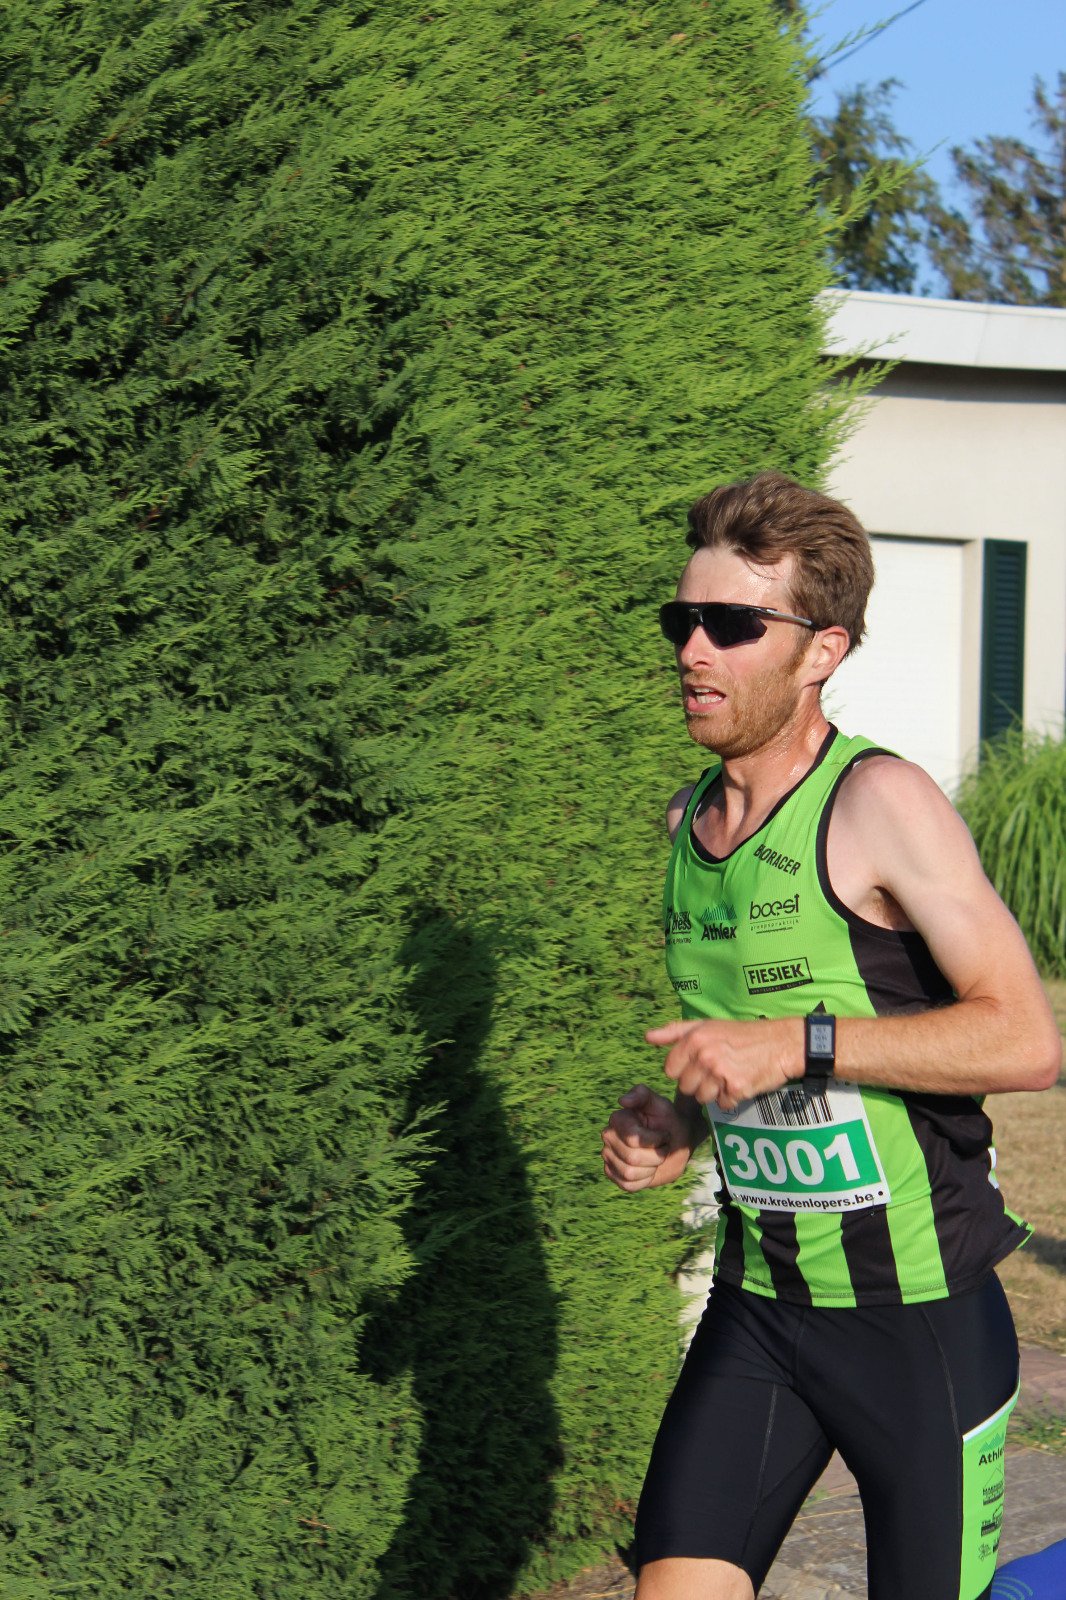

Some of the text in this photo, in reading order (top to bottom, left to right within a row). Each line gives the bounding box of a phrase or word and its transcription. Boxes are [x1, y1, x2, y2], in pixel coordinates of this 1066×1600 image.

[701, 922, 737, 941] Athlex
[747, 963, 804, 985] FIESIEK
[724, 1132, 861, 1186] 3001
[741, 1192, 874, 1209] www.krekenlopers.be
[978, 1446, 1004, 1466] Athle
